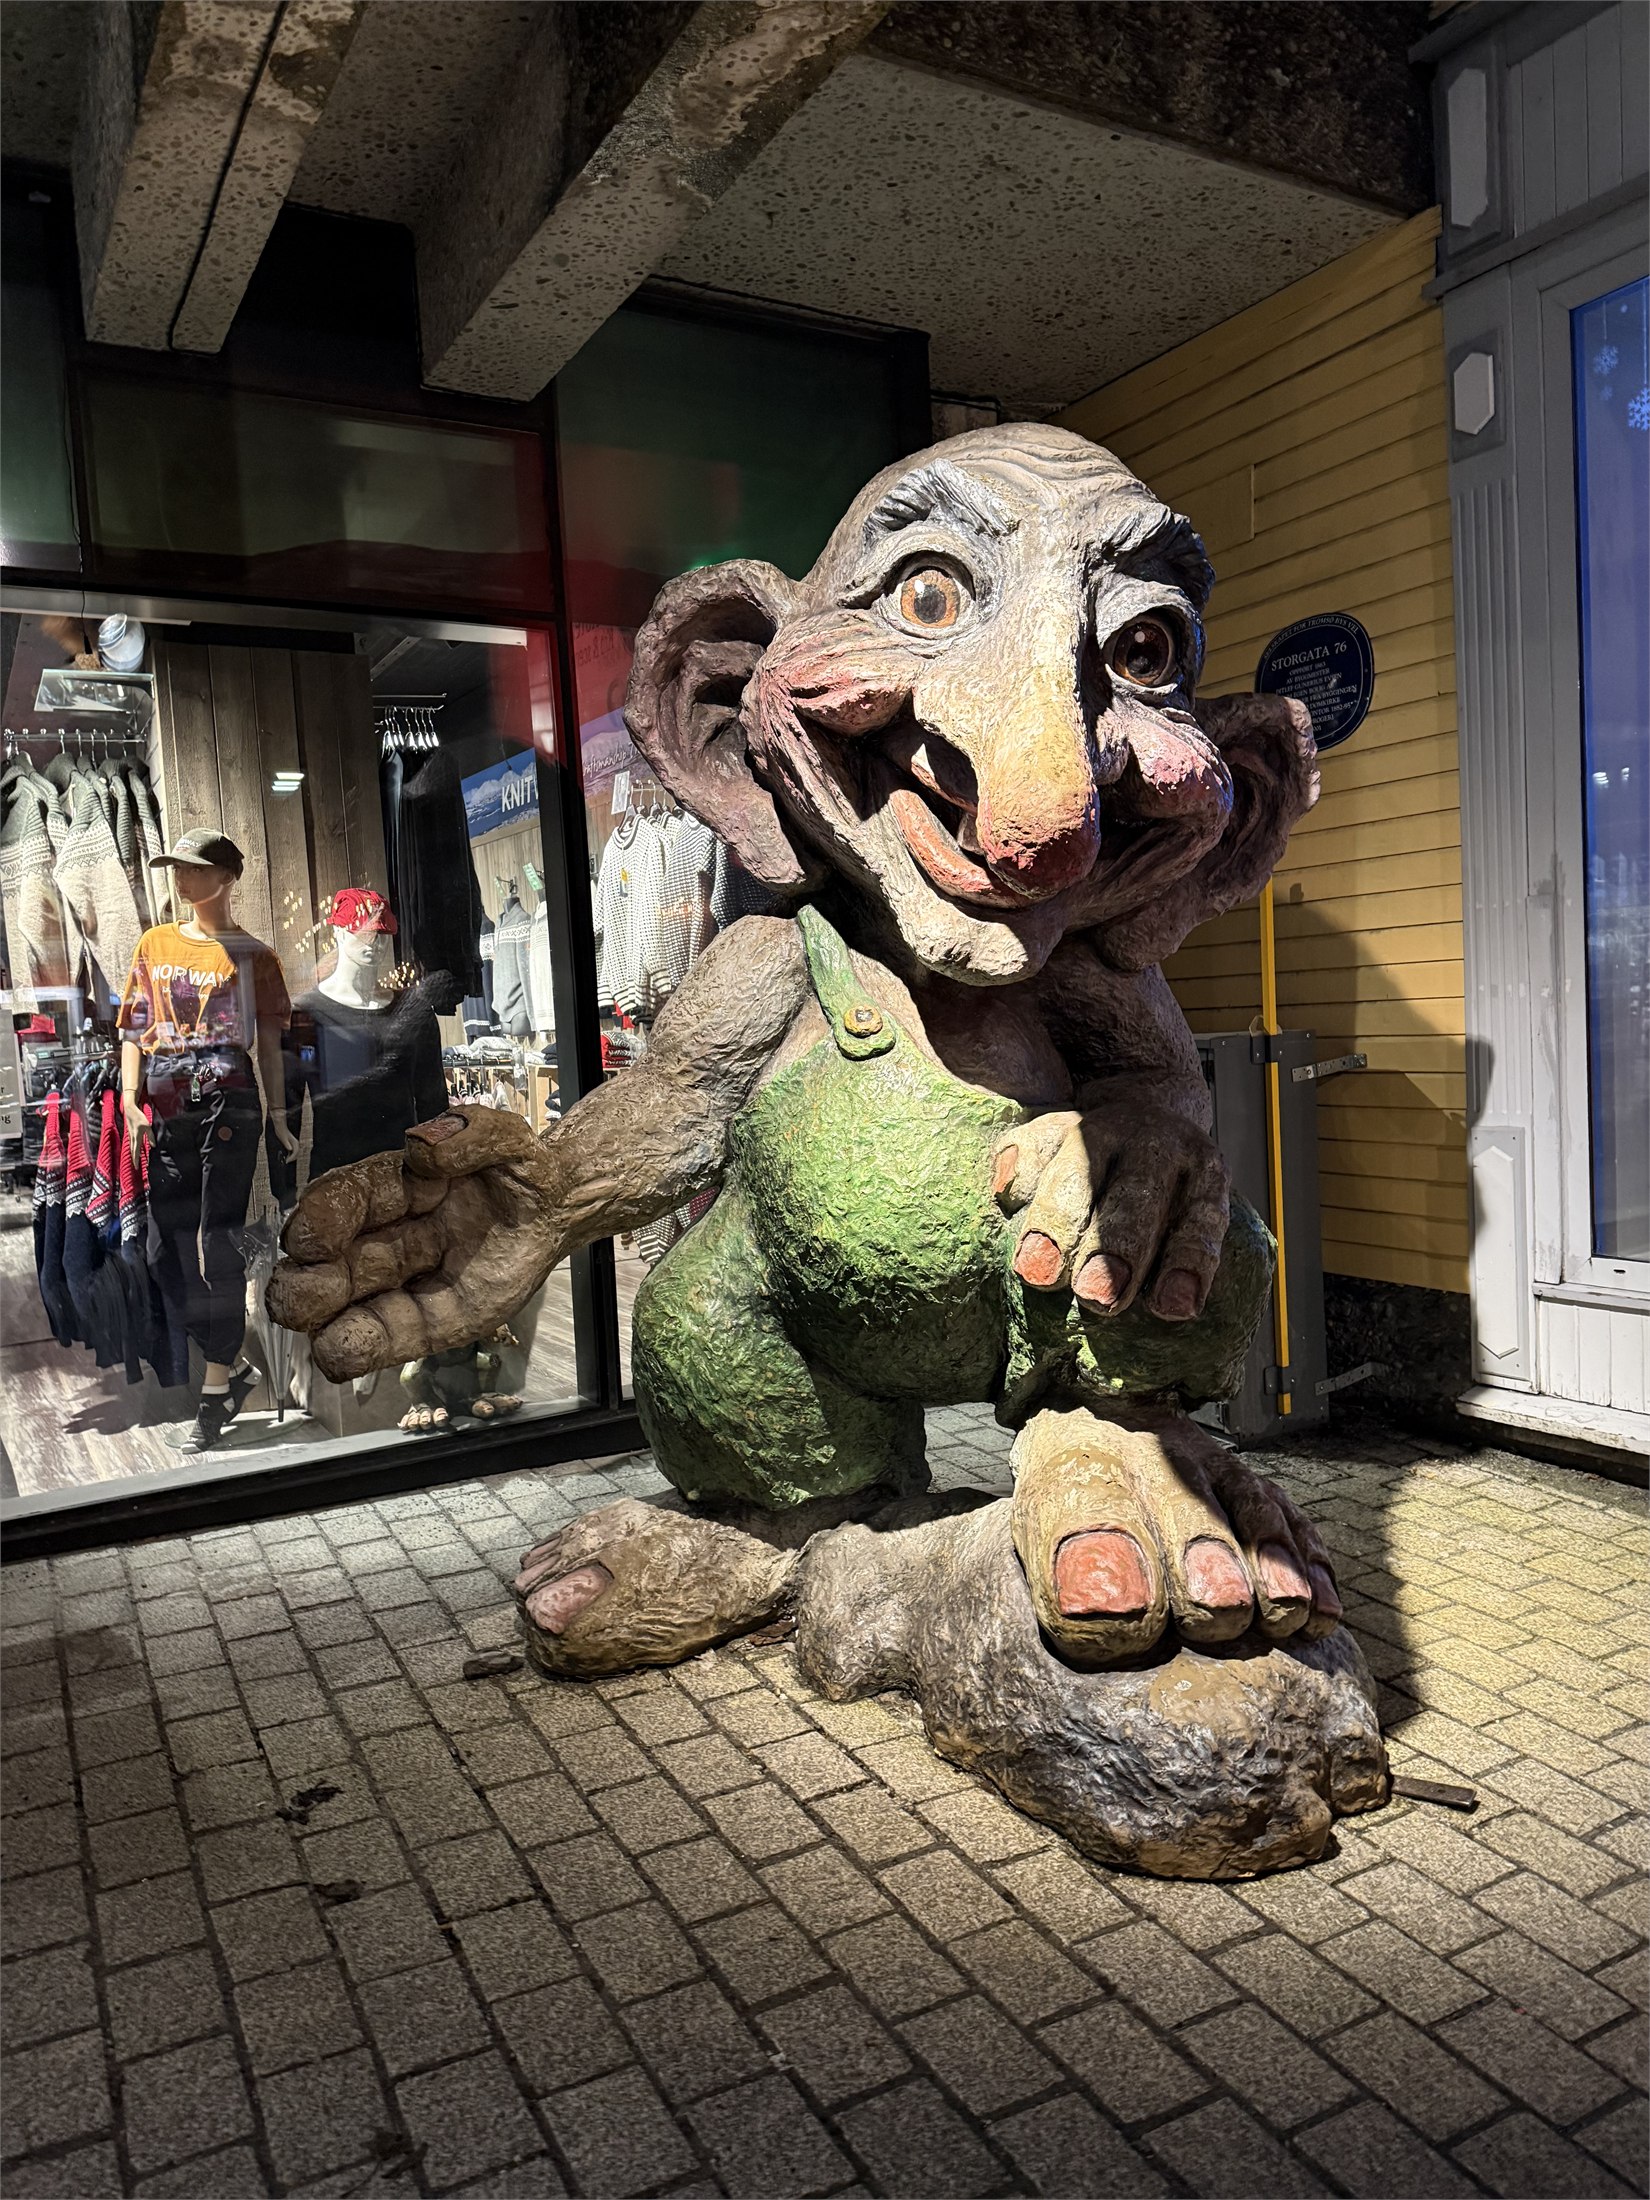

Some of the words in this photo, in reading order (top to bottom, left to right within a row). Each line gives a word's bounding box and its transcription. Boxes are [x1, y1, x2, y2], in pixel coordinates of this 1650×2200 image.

[1347, 621, 1360, 635] VEL
[1271, 645, 1330, 672] STORGATA
[1333, 640, 1347, 654] 76
[152, 963, 232, 988] NORWAY
